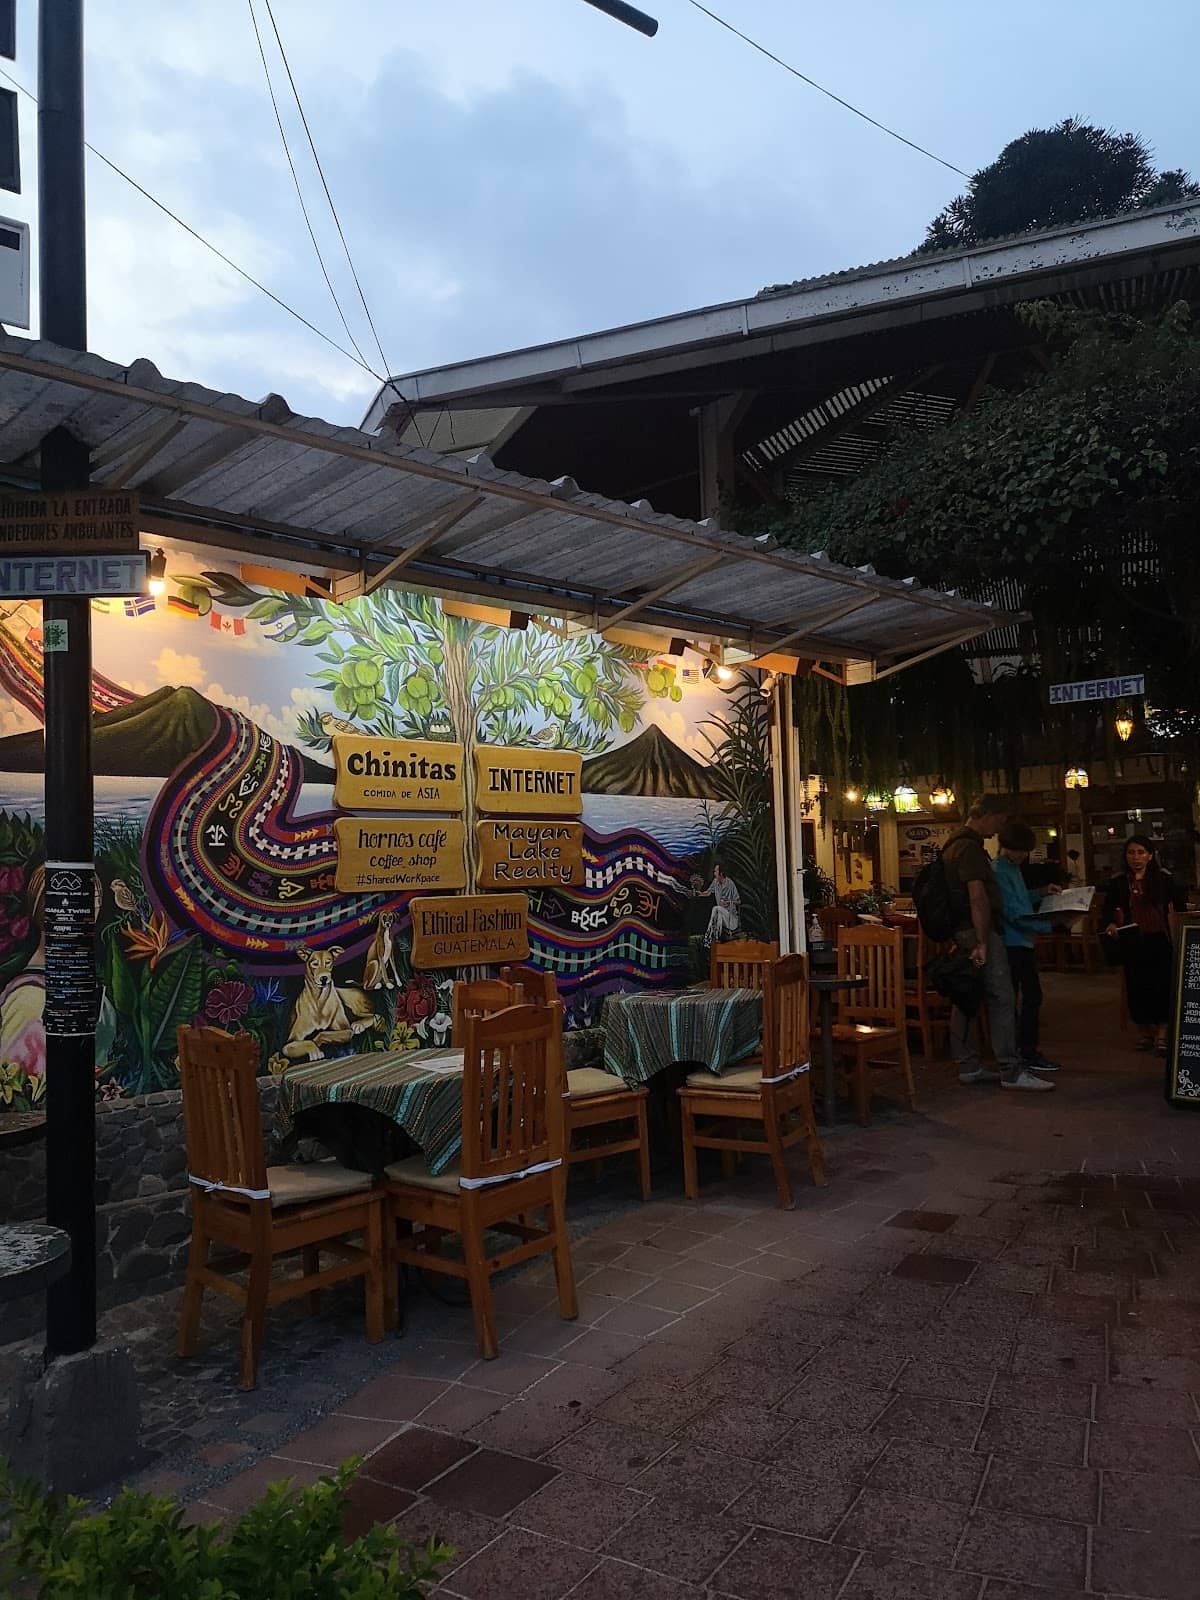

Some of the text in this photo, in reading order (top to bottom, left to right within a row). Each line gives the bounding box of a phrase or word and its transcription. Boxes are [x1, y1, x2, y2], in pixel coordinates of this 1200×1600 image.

[54, 500, 69, 518] LA
[75, 498, 132, 516] ENTRADA
[64, 520, 134, 540] AMBULANTES
[1051, 677, 1144, 702] INTERNET
[347, 750, 457, 781] Chinitas
[488, 767, 576, 795] INTERNET
[363, 786, 440, 800] COMIDA DE ASIA
[358, 828, 415, 849] hornos
[493, 823, 572, 845] Mayan
[408, 853, 437, 868] shop
[508, 841, 562, 861] Lake
[493, 862, 573, 884] Realty
[421, 907, 522, 937] Ethical Fashion
[433, 937, 516, 955] GUATEMALA
